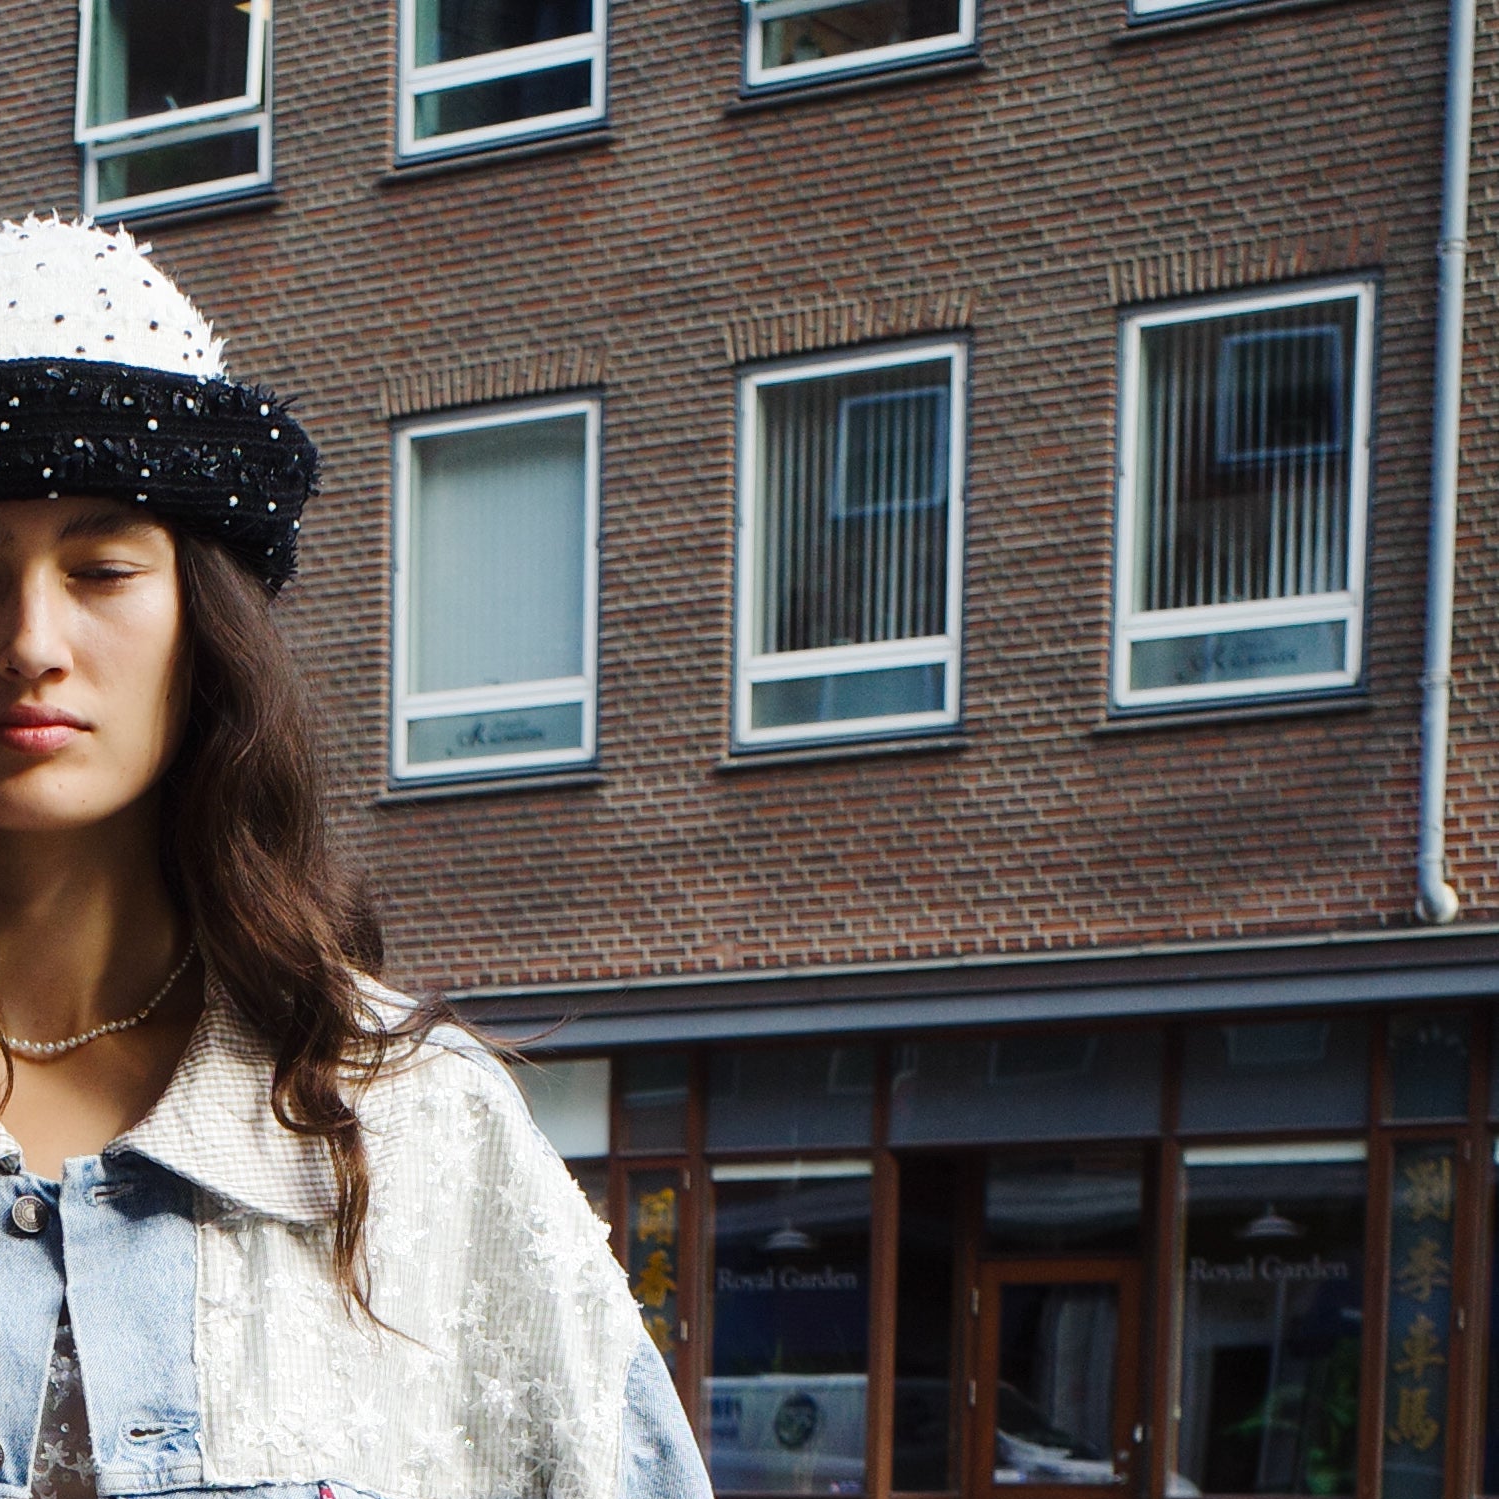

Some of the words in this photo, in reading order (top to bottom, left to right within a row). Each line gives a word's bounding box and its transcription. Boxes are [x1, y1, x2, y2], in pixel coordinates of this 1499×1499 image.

[716, 1266, 775, 1292] Royal
[780, 1264, 858, 1290] Garden
[1190, 1255, 1254, 1283] Royal
[1259, 1252, 1349, 1281] Garden
